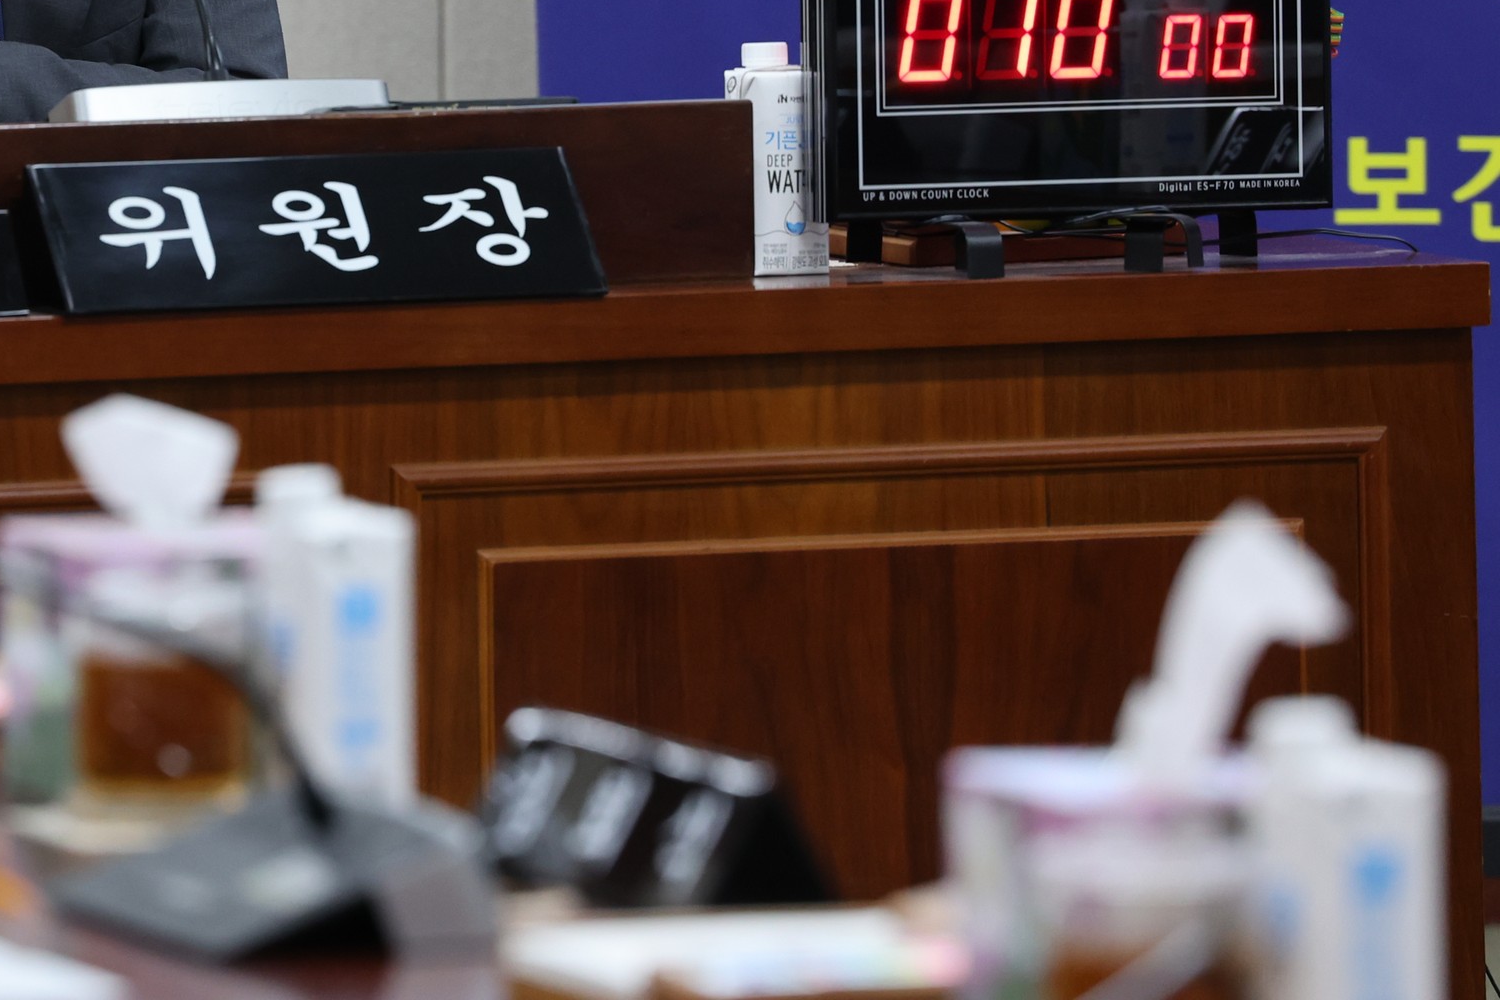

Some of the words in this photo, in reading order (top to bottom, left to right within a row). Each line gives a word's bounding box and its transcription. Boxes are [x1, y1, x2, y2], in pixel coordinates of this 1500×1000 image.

[1158, 13, 1255, 80] 00
[766, 153, 793, 168] DEEP
[1158, 181, 1192, 193] Digital
[1239, 179, 1261, 189] MADE
[1263, 179, 1271, 188] IN
[1273, 178, 1300, 187] KOREA
[862, 191, 875, 202] UP
[879, 191, 885, 201] &
[889, 190, 918, 200] DOWN
[920, 189, 954, 200] COUNT
[956, 188, 989, 199] CLOCK
